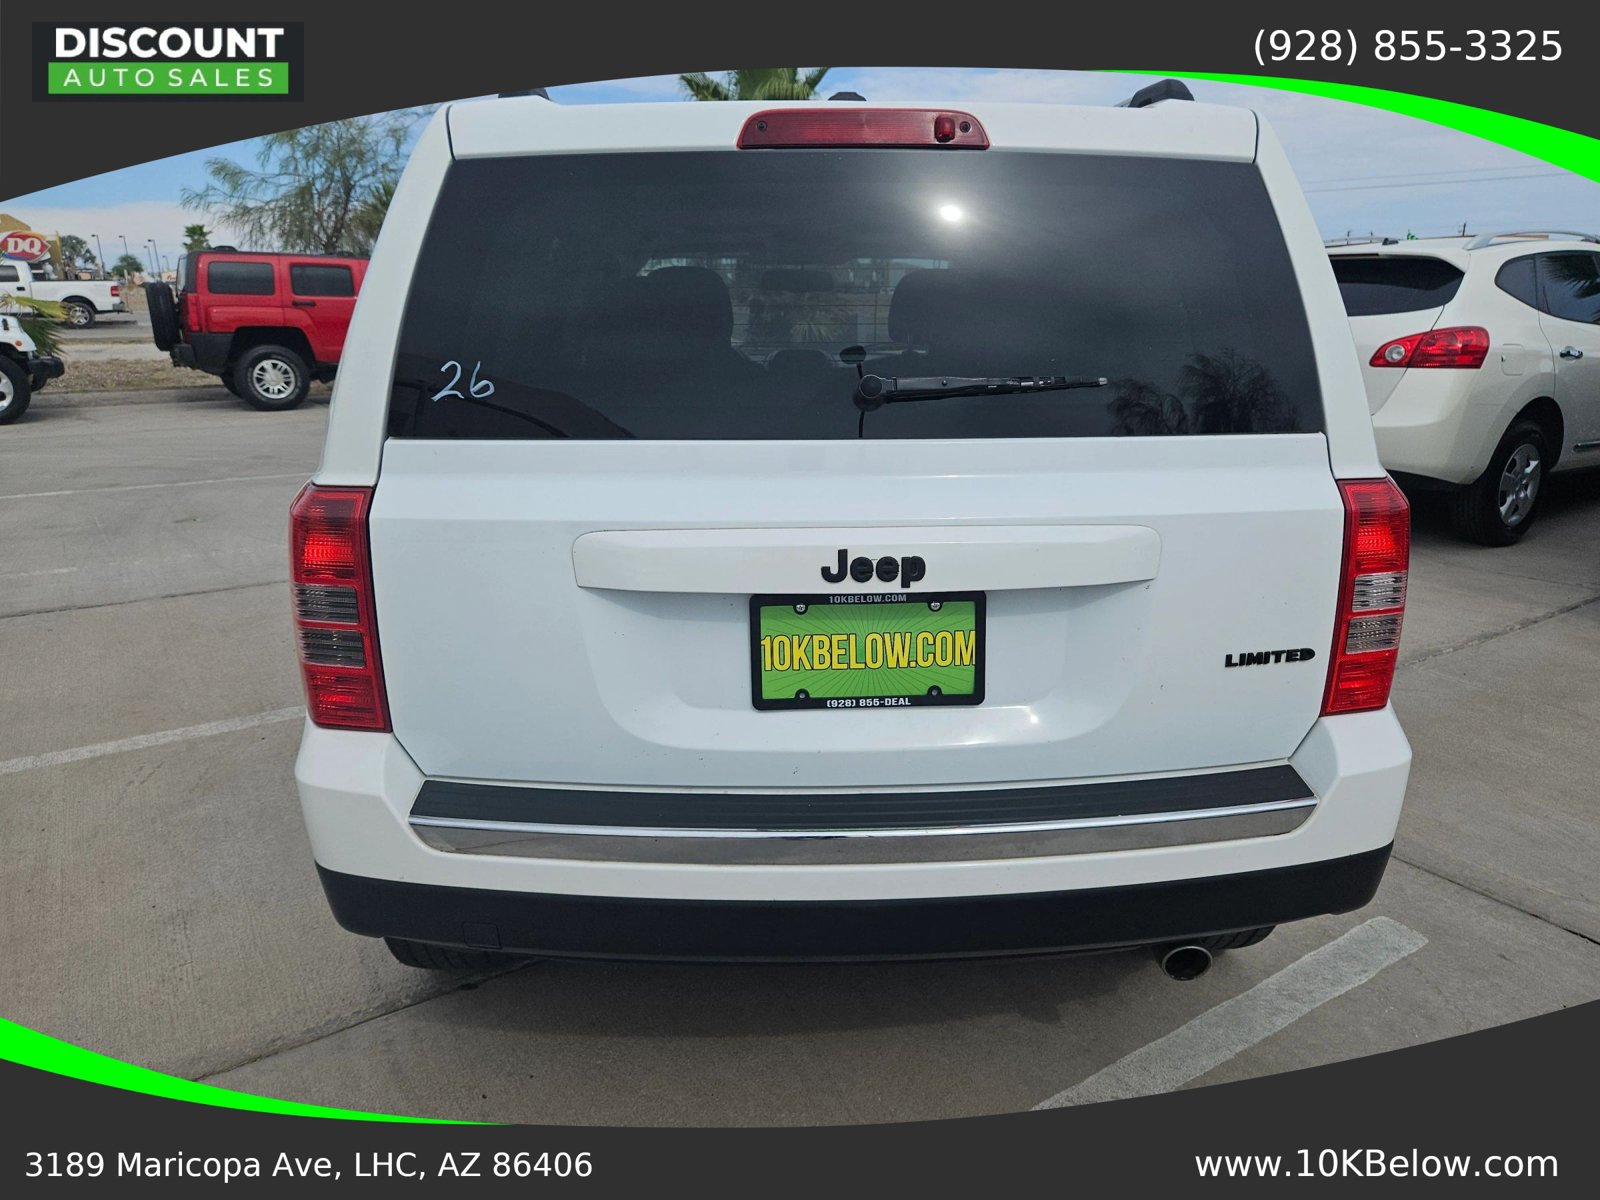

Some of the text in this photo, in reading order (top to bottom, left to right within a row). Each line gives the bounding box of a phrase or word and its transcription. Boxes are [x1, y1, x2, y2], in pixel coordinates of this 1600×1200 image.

[6, 237, 42, 254] DQ
[431, 360, 495, 402] 26
[820, 548, 926, 589] Jeep
[828, 593, 907, 604] 10KBELOW.COM
[760, 630, 976, 671] 10KBELOW.COM
[1225, 647, 1316, 668] LIMITED
[826, 698, 911, 708] (928) 855-DEAL
